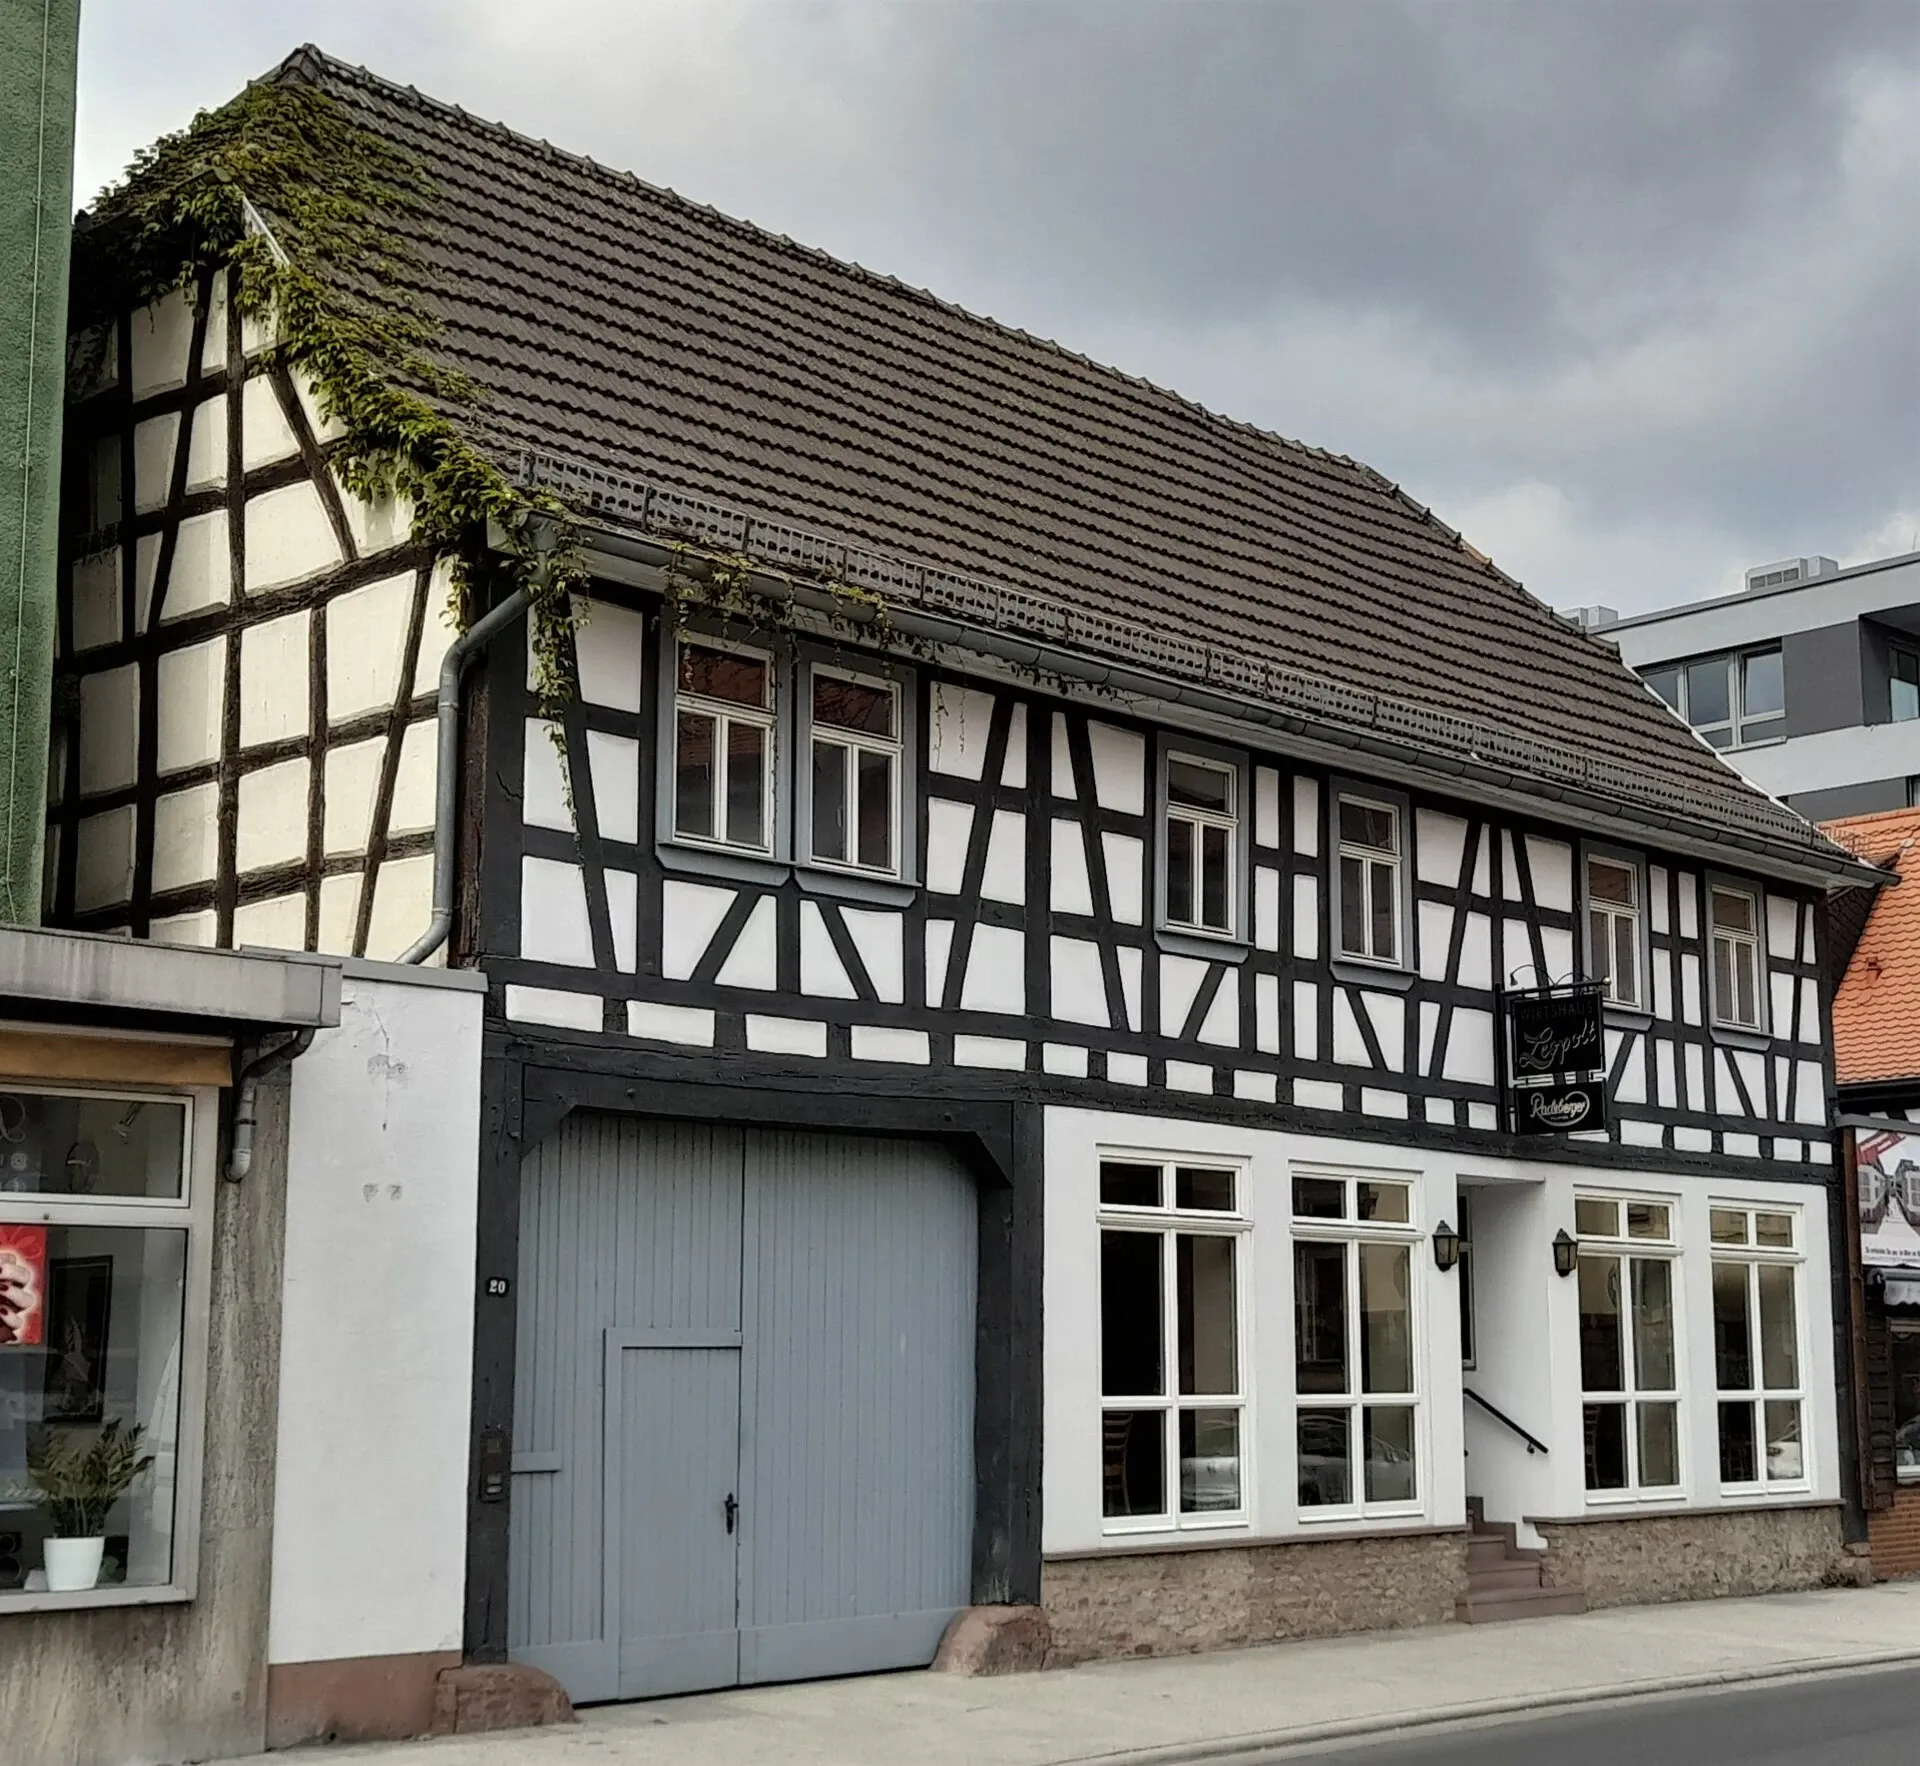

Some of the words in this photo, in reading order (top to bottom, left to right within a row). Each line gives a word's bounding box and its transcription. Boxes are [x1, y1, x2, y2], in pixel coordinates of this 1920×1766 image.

[1520, 1000, 1593, 1021] WIRTSHAUS
[1530, 1092, 1588, 1121] Radeberger
[488, 1279, 506, 1294] 20
